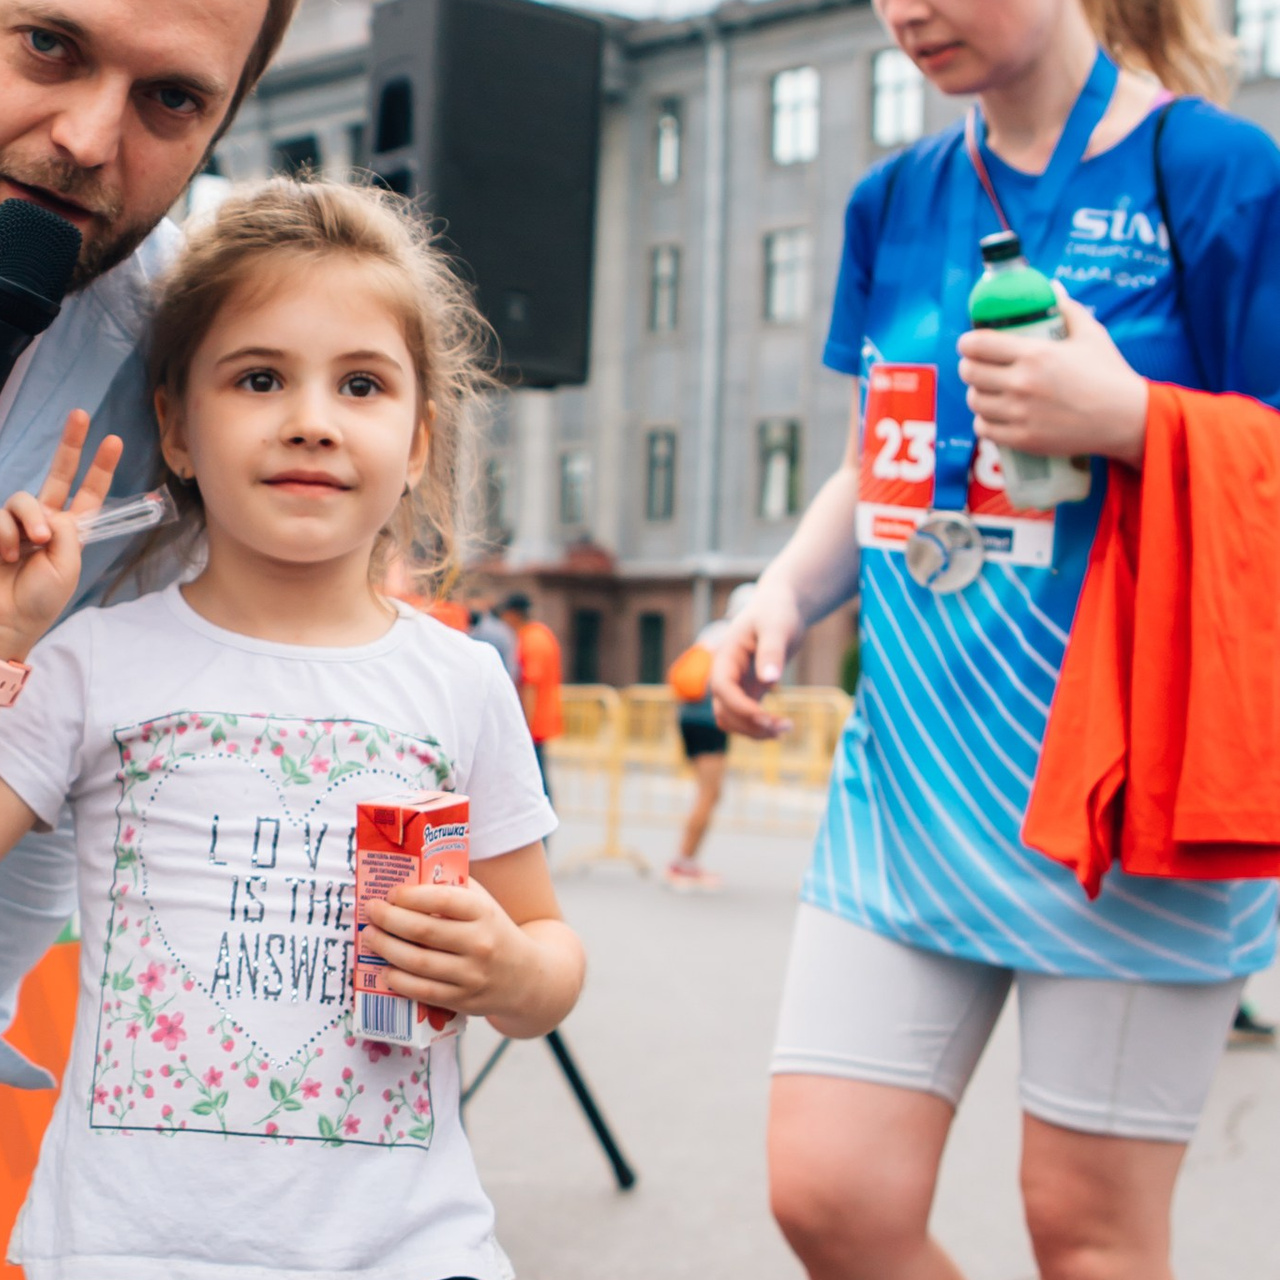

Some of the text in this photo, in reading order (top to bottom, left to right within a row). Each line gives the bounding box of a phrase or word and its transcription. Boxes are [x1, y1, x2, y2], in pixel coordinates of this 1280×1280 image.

[424, 825, 466, 845] Растишка
[230, 875, 355, 930] IS THE
